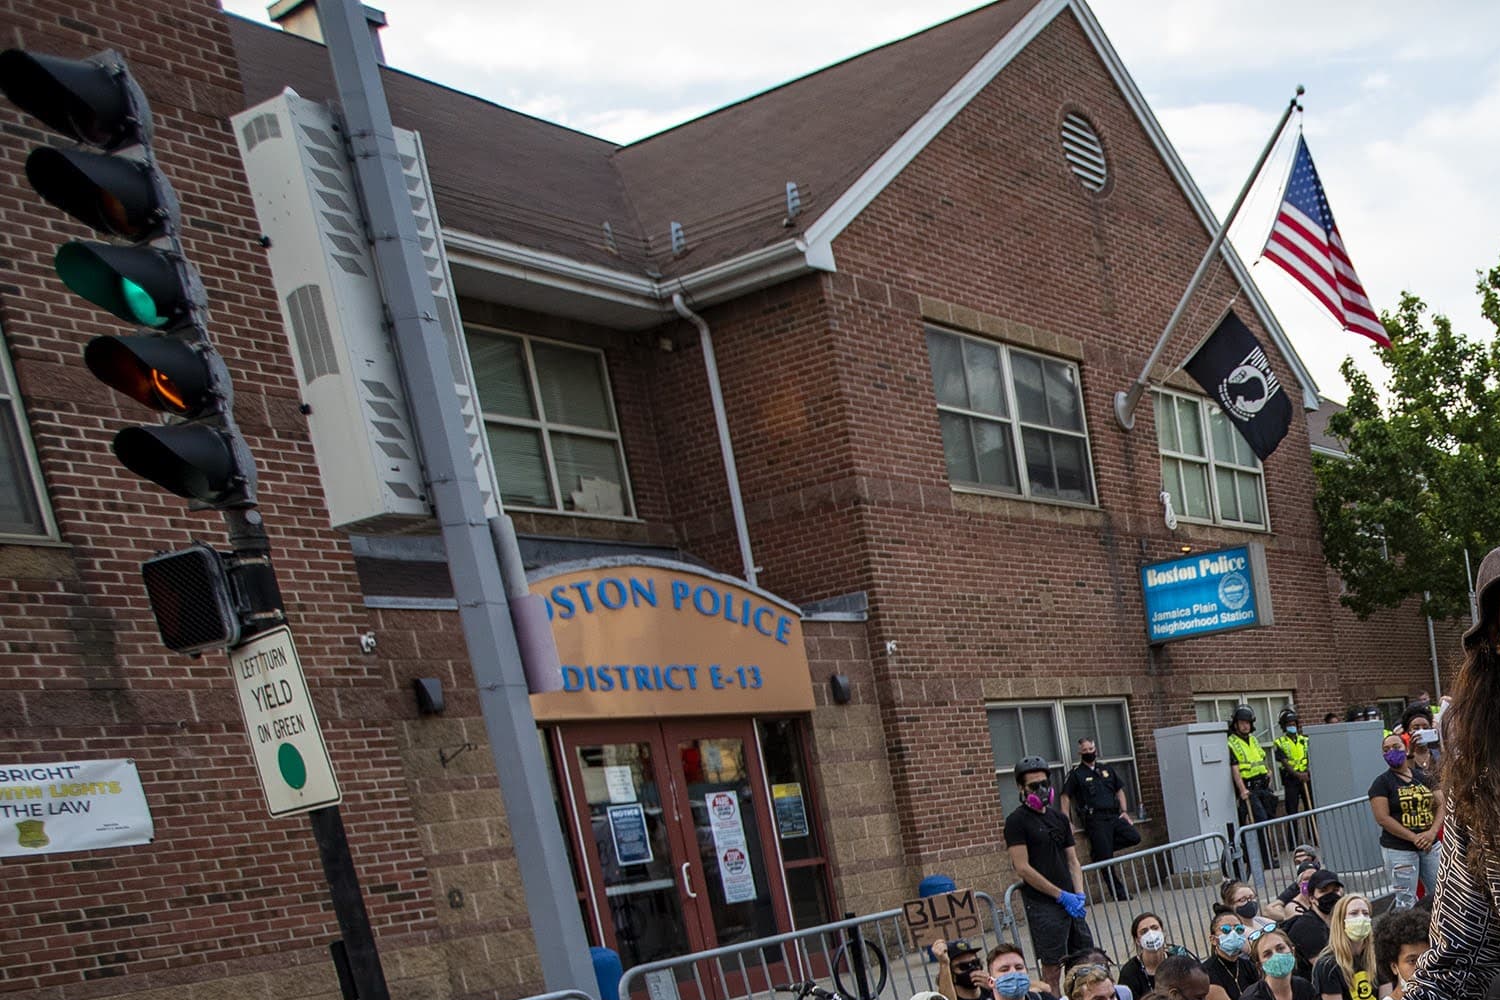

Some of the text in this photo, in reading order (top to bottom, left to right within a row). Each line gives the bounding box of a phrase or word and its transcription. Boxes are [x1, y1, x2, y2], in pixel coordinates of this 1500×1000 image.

[1147, 556, 1245, 587] Boston Police
[546, 577, 793, 645] STON POLICE
[1152, 603, 1217, 622] Jamaica Plain
[1154, 610, 1254, 634] Neighborhood Station
[240, 654, 262, 679] LEFT
[562, 664, 763, 692] DISTRICT E-13
[251, 679, 293, 712] YIELD
[257, 714, 306, 744] ON GREEN
[49, 780, 122, 798] LIGHTS
[48, 800, 91, 815] LAW
[904, 890, 975, 926] BLM
[911, 916, 978, 947] FTP
